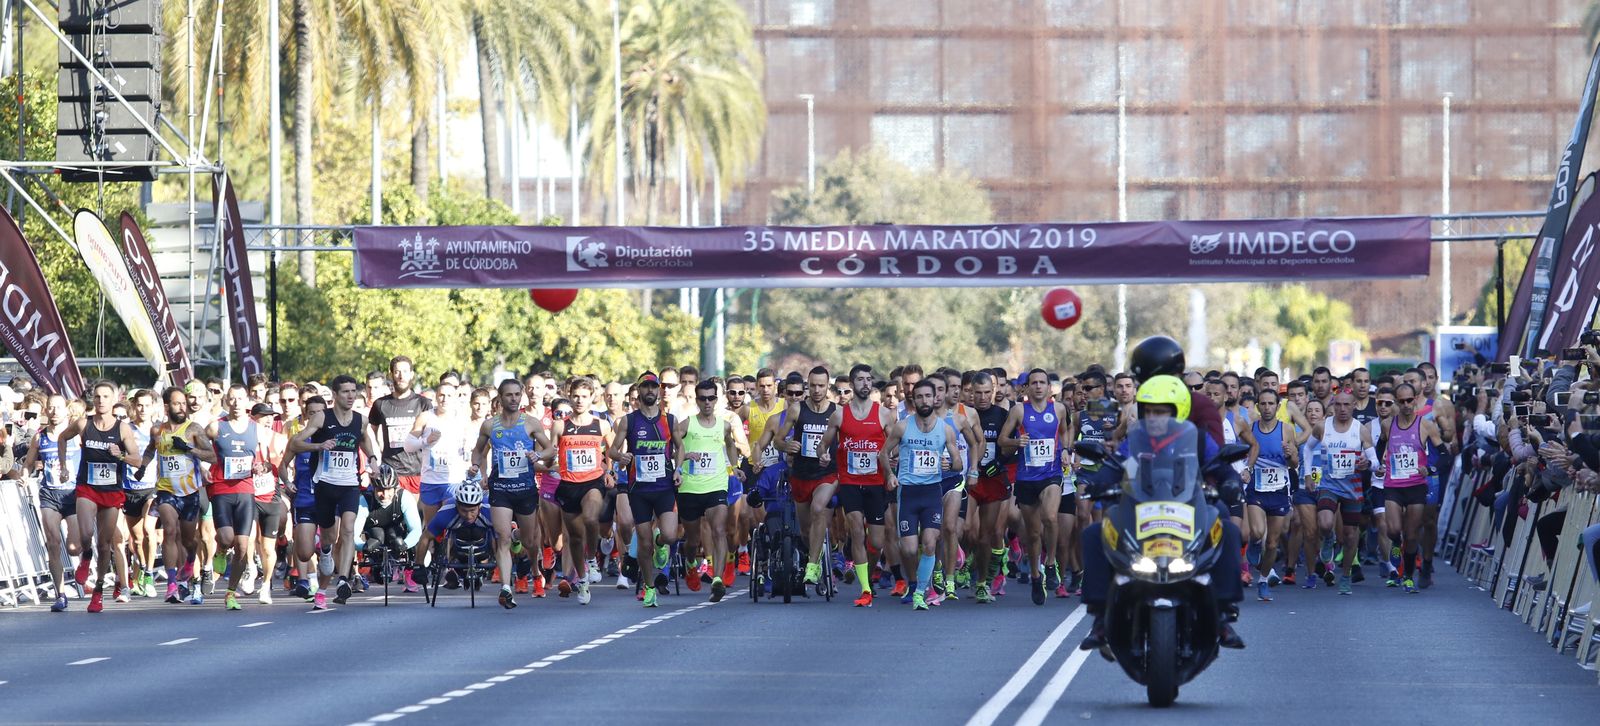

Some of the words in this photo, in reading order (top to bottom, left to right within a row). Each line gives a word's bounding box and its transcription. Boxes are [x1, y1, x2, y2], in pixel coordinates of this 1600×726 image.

[743, 230, 776, 252] 35
[783, 229, 876, 251] MEDIA
[883, 226, 1020, 251] MARATÓN
[1028, 227, 1097, 249] 2019
[1227, 229, 1356, 255] IMDECO
[445, 240, 531, 255] AYUNTAMIENTO
[615, 245, 693, 259] Diputación
[446, 258, 460, 270] DE
[462, 255, 518, 270] CÓRDOBA
[615, 259, 632, 268] de
[636, 258, 693, 268] Córdoba
[799, 253, 1058, 276] CÓRDOBA
[1189, 258, 1223, 266] Instituto
[1225, 257, 1266, 266] Municipal
[1267, 257, 1278, 265] de
[1280, 257, 1318, 267] Deportes
[850, 439, 878, 449] califas
[907, 438, 933, 447] nerja
[764, 447, 776, 457] 91
[1034, 445, 1051, 456] 151
[332, 457, 350, 468] 100
[509, 456, 521, 467] 67
[576, 455, 593, 465] 104
[700, 458, 712, 468] 87
[859, 458, 871, 468] 59
[918, 457, 936, 468] 149
[1335, 459, 1352, 469] 144
[1399, 459, 1415, 469] 134
[167, 461, 180, 472] 96
[647, 461, 660, 472] 98
[99, 468, 111, 479] 48
[1267, 473, 1279, 484] 24
